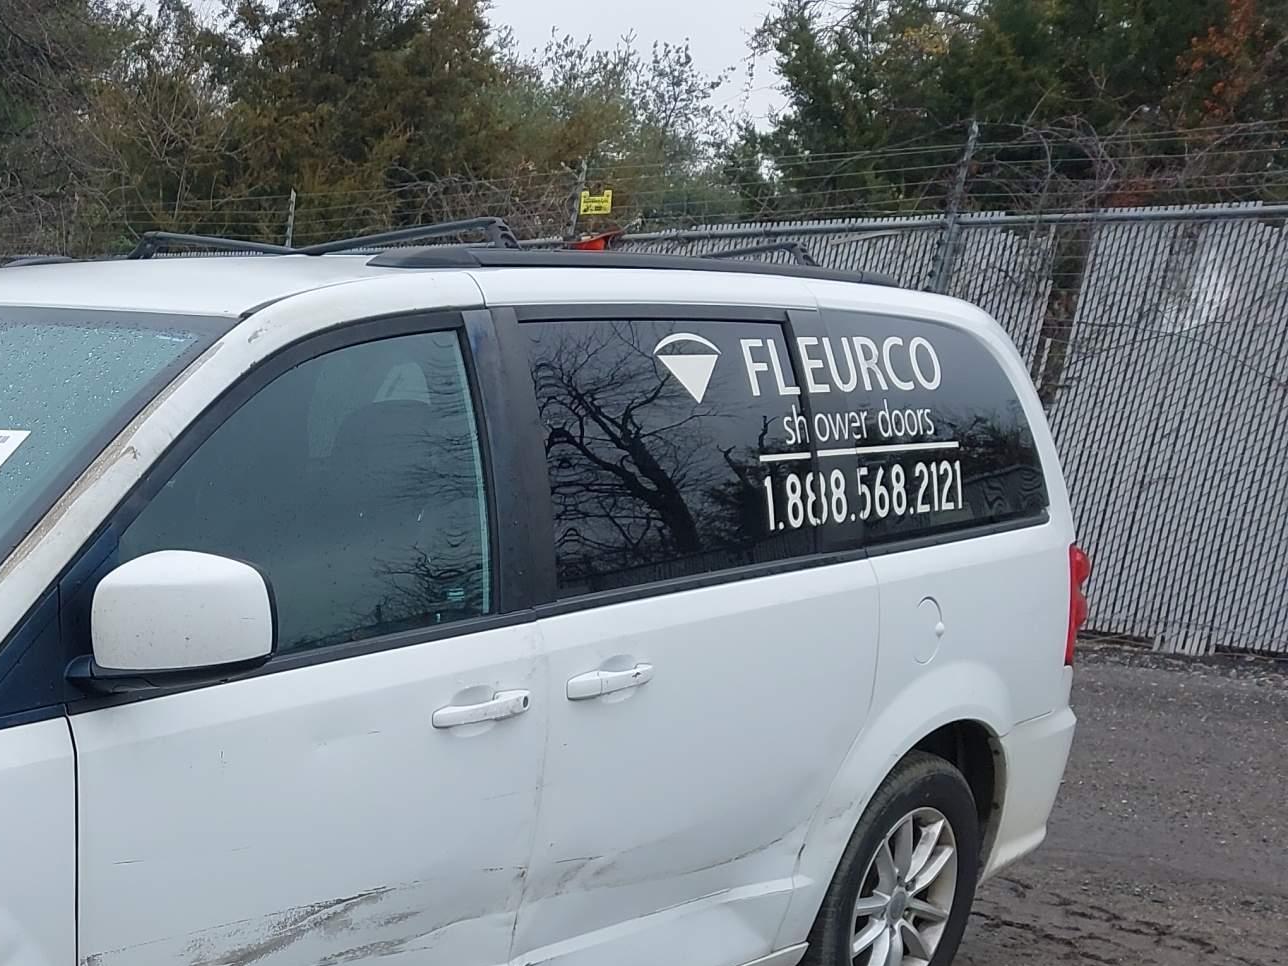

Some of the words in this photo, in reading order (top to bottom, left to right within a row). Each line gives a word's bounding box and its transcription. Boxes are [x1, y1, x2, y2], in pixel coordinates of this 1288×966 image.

[739, 335, 943, 397] FLEURCO
[783, 403, 868, 445] shower
[878, 398, 935, 438] doors
[764, 459, 963, 531] 1.888.568.2121
